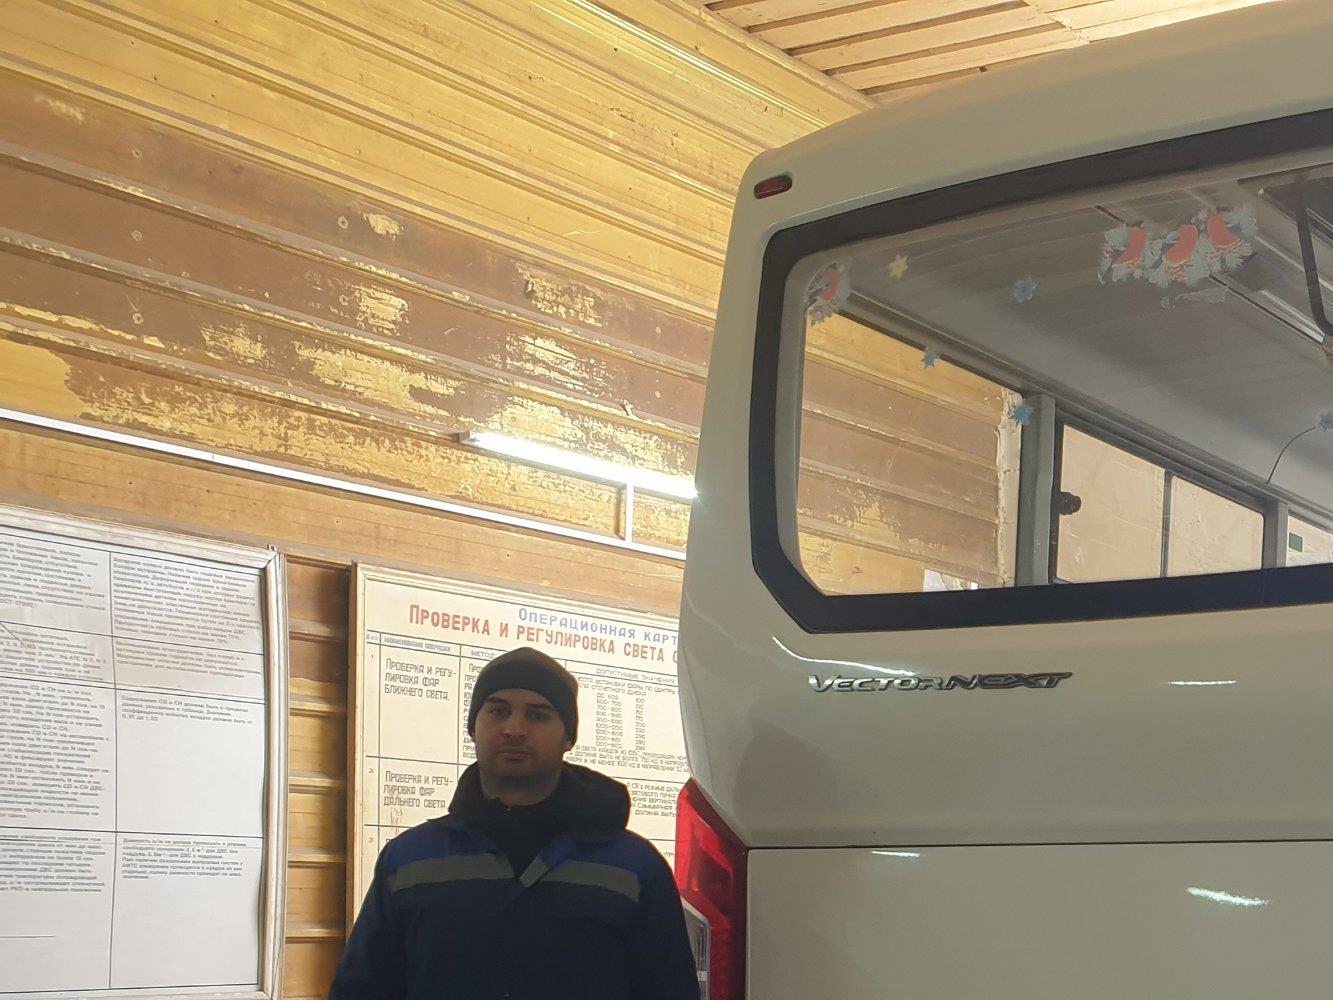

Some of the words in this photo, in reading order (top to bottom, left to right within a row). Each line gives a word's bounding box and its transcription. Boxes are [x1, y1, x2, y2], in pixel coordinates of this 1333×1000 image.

[518, 607, 636, 640] ОПЕРАЦИОННАЯ
[409, 604, 491, 637] ПРОВЕРКА
[500, 622, 509, 639] И
[516, 624, 616, 655] РЕГУЛИРОВКА
[623, 642, 665, 662] СВЕТА
[386, 658, 424, 674] ПРОВЕРКА
[427, 665, 432, 675] И
[422, 676, 440, 688] ФАР
[384, 684, 423, 698] БЛИЖНЕГО
[385, 771, 422, 783] ПРОВЕРКА
[424, 775, 429, 783] И
[418, 788, 435, 797] ФАР
[383, 796, 420, 807] ДАЛЬНЕГО
